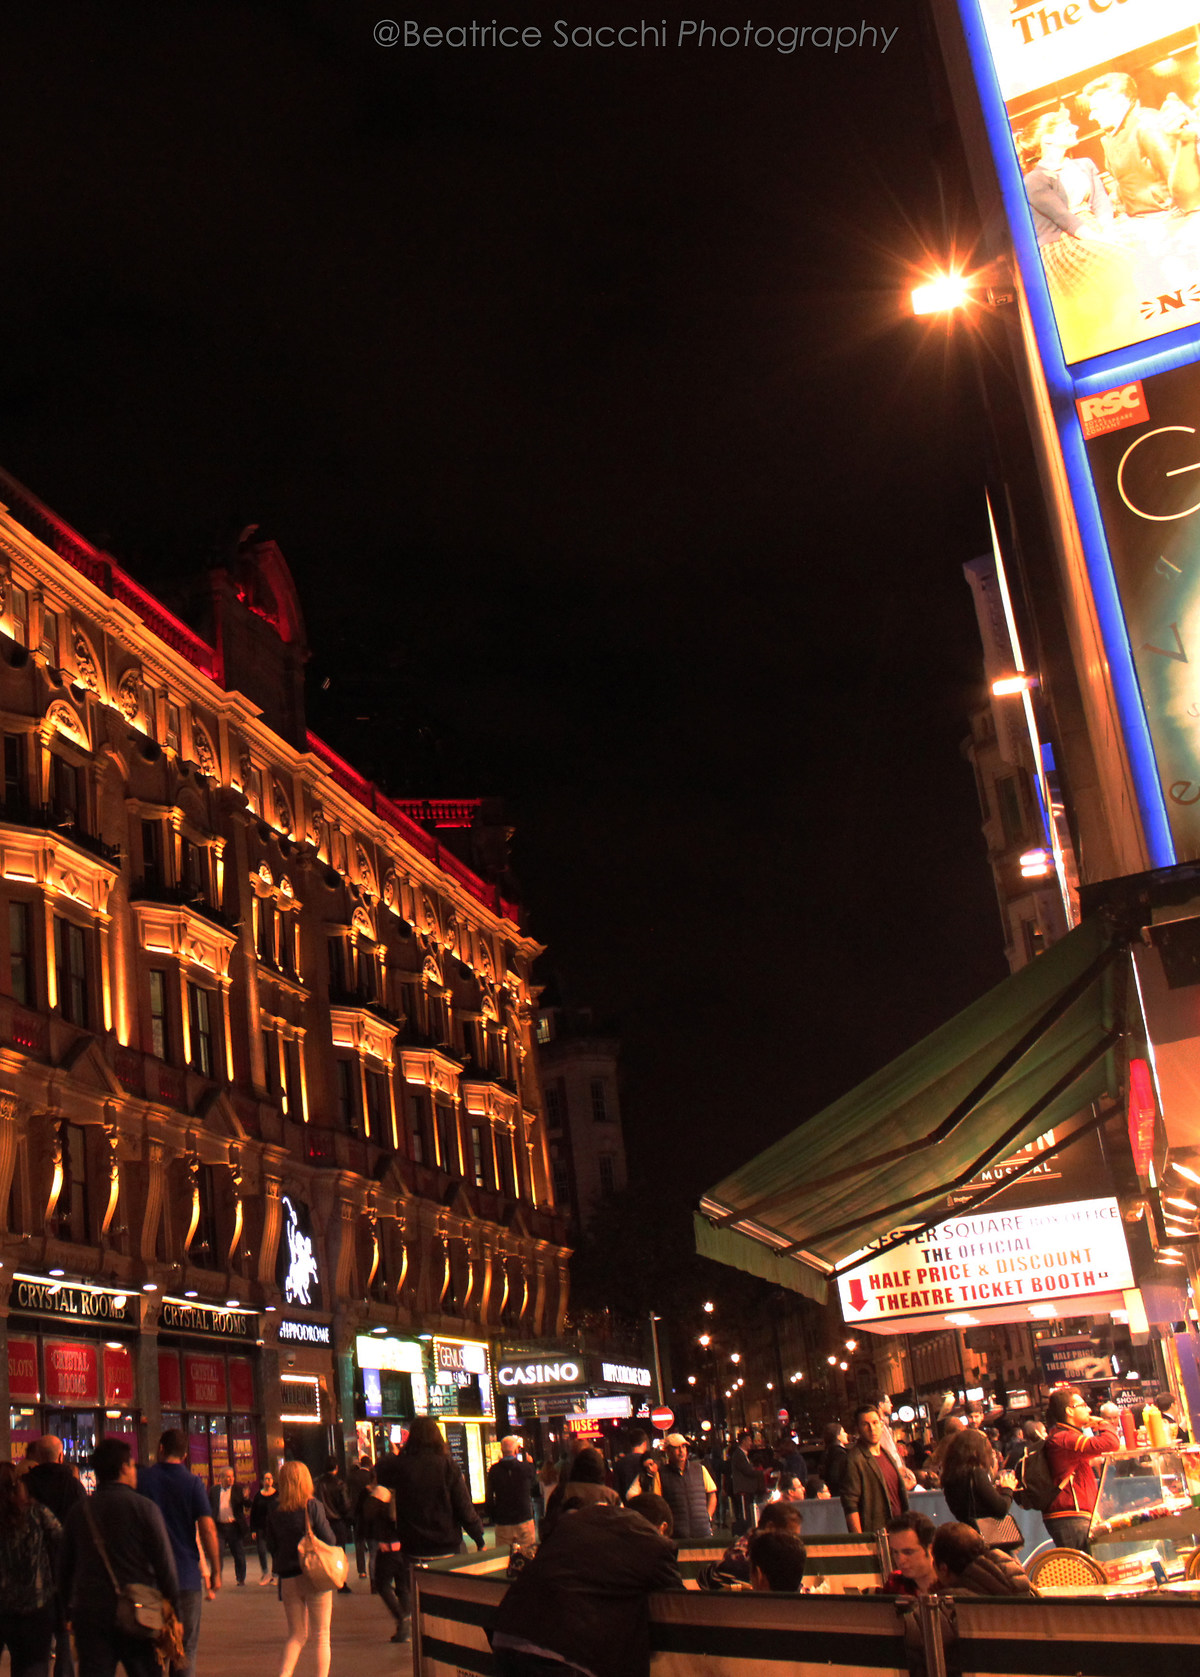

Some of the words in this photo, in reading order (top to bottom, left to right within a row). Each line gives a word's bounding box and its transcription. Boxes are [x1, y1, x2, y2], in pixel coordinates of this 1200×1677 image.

[1012, 3, 1083, 45] The
[1080, 385, 1140, 422] RSC
[943, 1215, 1023, 1240] SQUARE
[921, 1247, 953, 1264] THE
[958, 1237, 1031, 1259] OFFICIAL
[869, 1270, 911, 1290] HALF
[916, 1263, 971, 1285] PRICE
[996, 1248, 1092, 1274] DISCOUNT
[18, 1283, 78, 1314] CRYSTAL
[81, 1292, 126, 1320] ROOMS
[875, 1287, 955, 1312] THEATRE
[959, 1279, 1024, 1302] TICKET
[1031, 1270, 1096, 1293] BOOTH
[163, 1304, 210, 1331] CRYSTAL
[212, 1313, 247, 1336] ROOMS
[279, 1320, 330, 1344] HIPPODROME
[8, 1359, 34, 1377] SLOTS
[53, 1350, 90, 1372] CRYSTAL
[1052, 1351, 1071, 1361] HALF
[58, 1373, 87, 1395] ROOMS
[498, 1362, 579, 1386] CASINO
[1121, 1390, 1136, 1398] ALL
